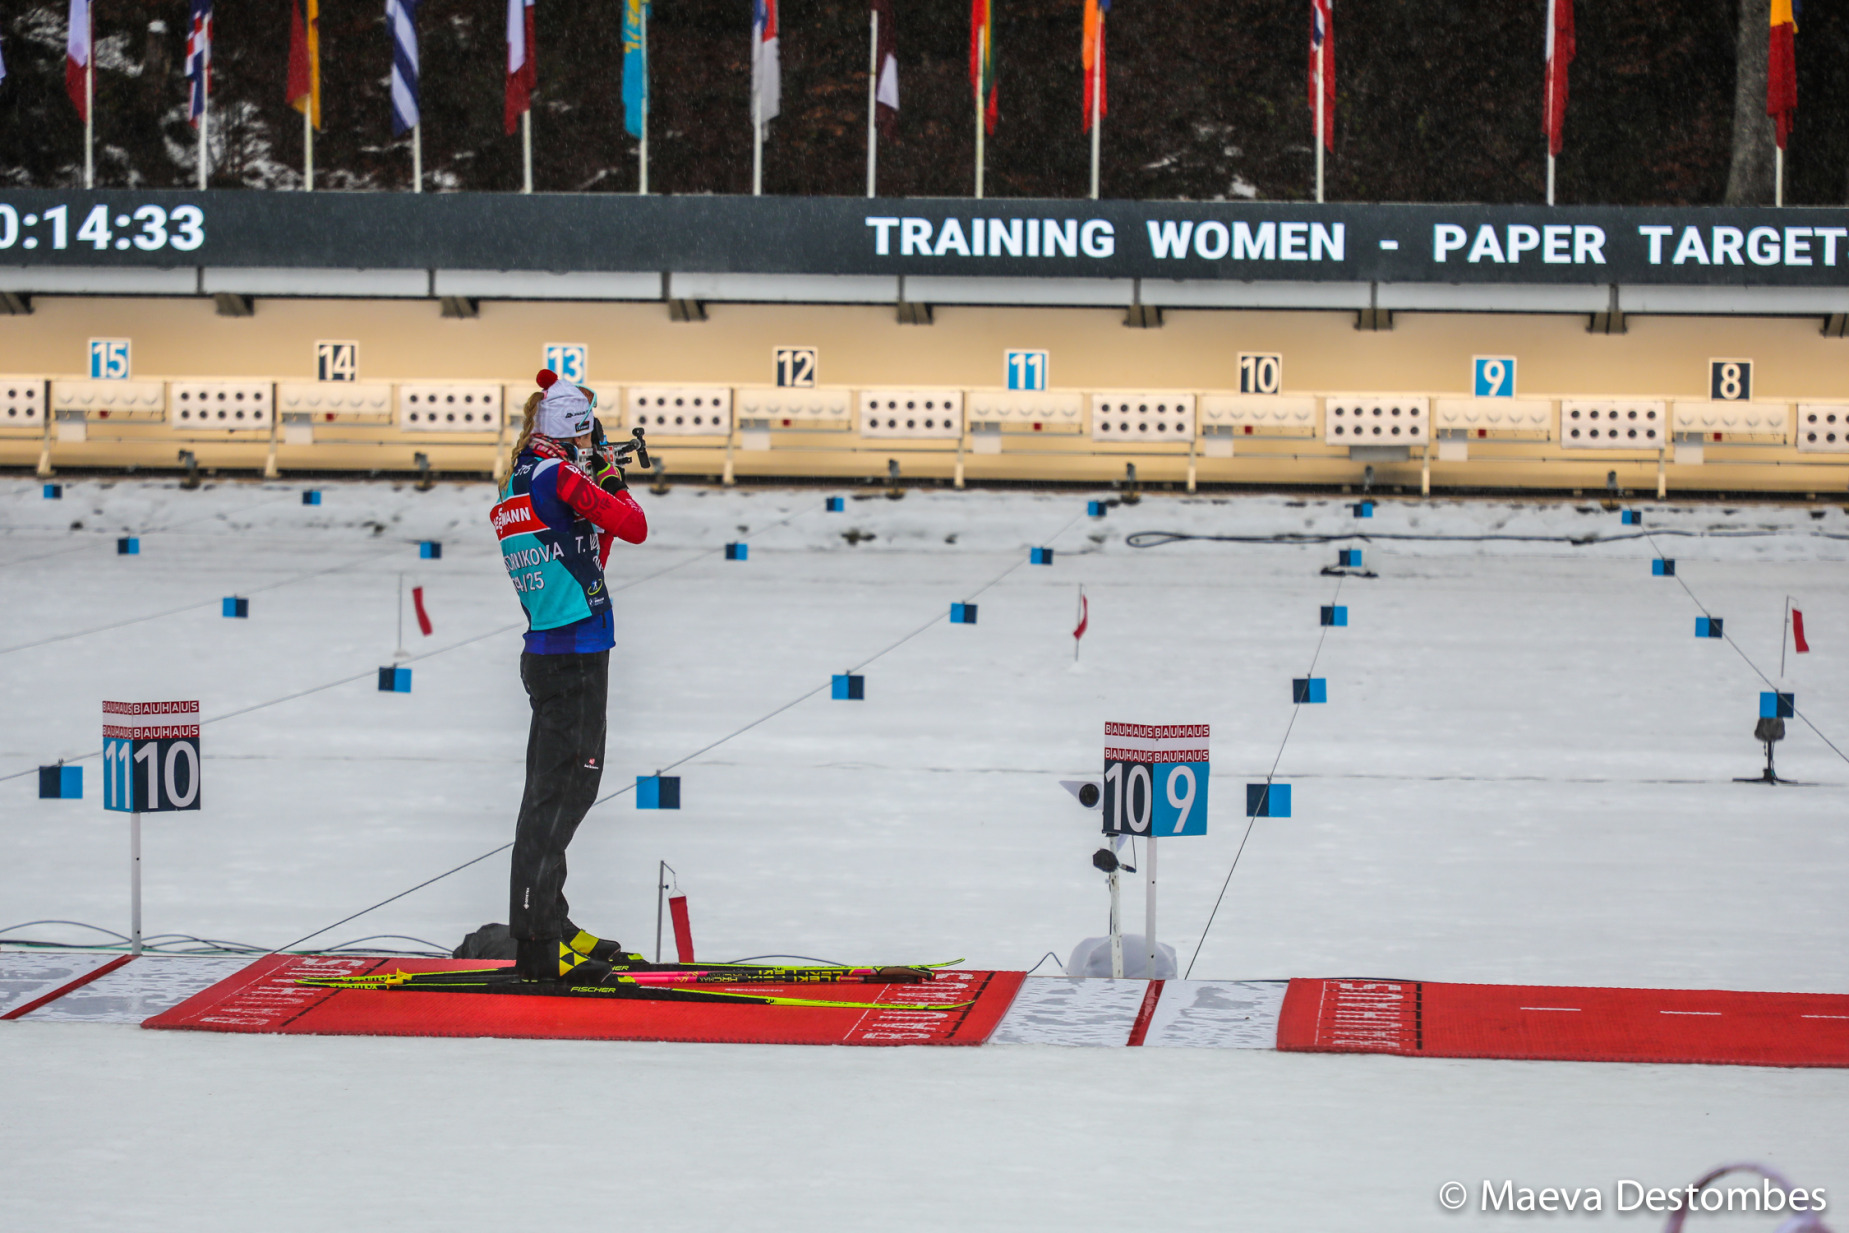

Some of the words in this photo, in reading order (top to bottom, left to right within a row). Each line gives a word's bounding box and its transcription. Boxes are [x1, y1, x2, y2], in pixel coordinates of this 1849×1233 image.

[865, 216, 1115, 259] TRAINING
[1146, 219, 1346, 261] WOMEN
[1433, 223, 1606, 264] PAPER
[1638, 225, 1849, 266] TARGET
[94, 343, 126, 378] 15
[319, 344, 354, 380] 14
[550, 347, 583, 383] 13
[777, 350, 813, 386] 12
[1009, 353, 1044, 389] 11
[1242, 356, 1278, 392] 10
[1482, 360, 1506, 396] 9
[1719, 363, 1742, 400] 8
[133, 701, 199, 714] BAUHAUS
[133, 725, 199, 739] BAUHAUS
[1105, 723, 1153, 737] BAUHAUS
[1154, 726, 1209, 737] BAUHAUS
[1105, 749, 1153, 762] BAUHAUS
[1154, 750, 1209, 762] BAUHAUS
[105, 740, 130, 809] 11
[133, 740, 199, 809] 10
[1105, 762, 1152, 833] 10
[1166, 765, 1197, 833] 9
[570, 986, 616, 994] FISCHER
